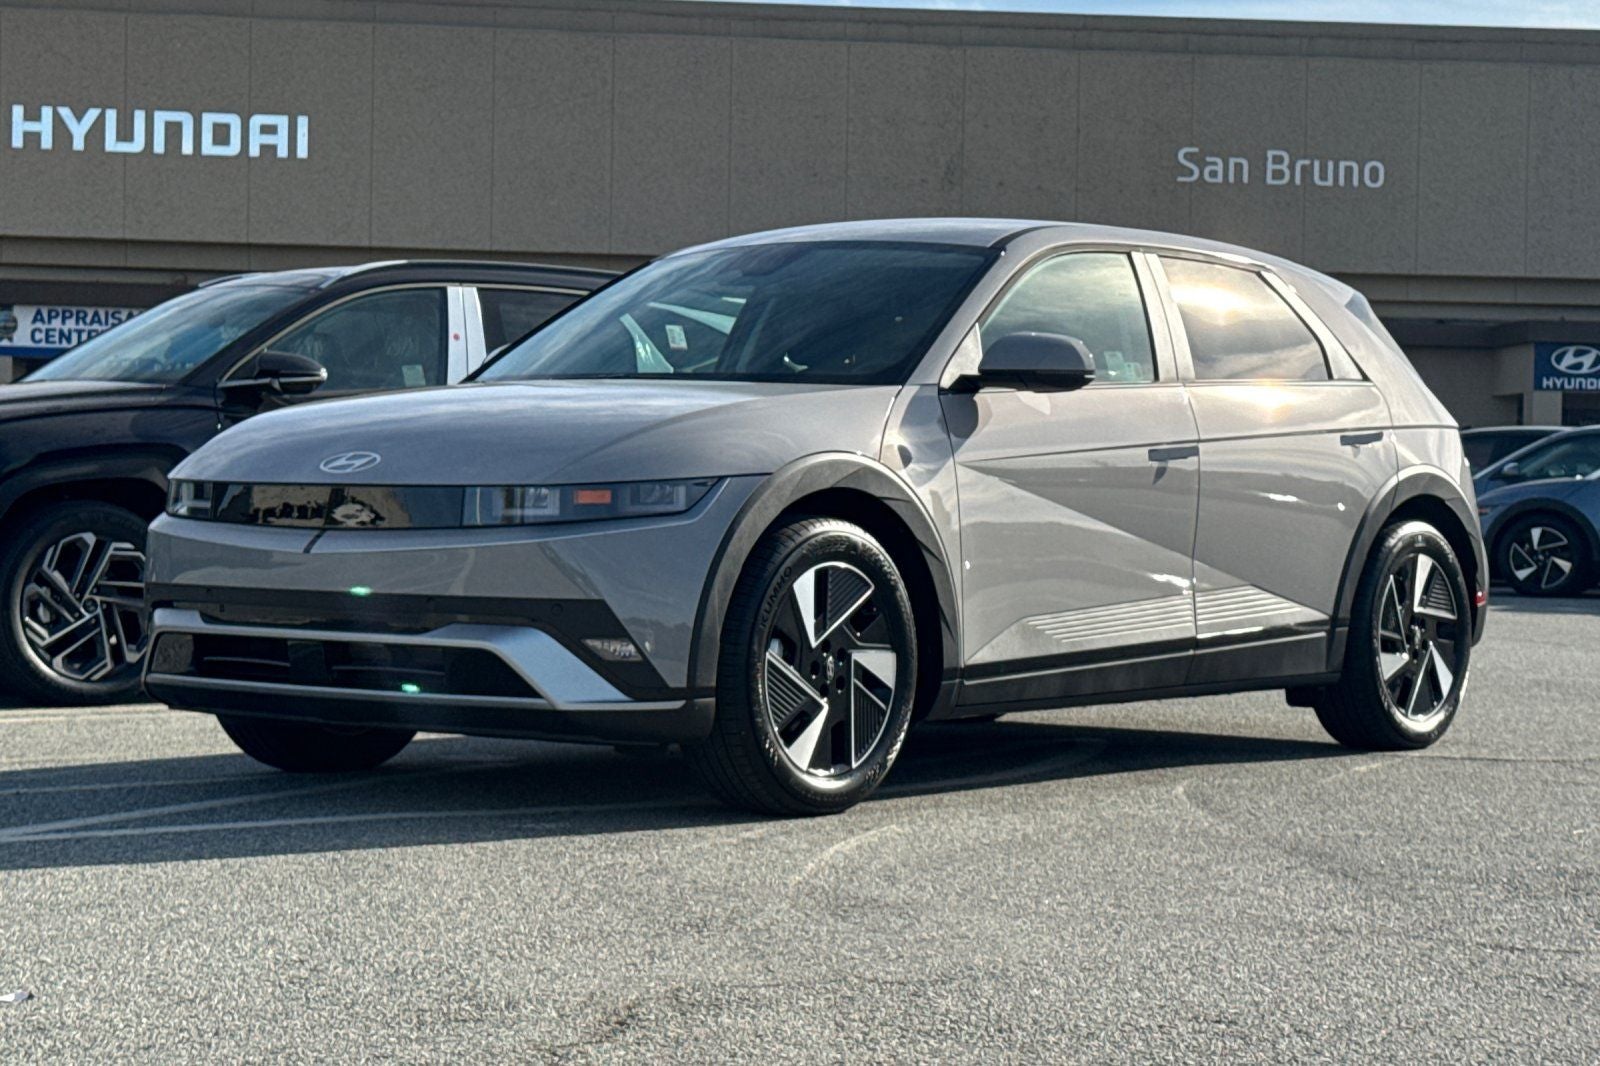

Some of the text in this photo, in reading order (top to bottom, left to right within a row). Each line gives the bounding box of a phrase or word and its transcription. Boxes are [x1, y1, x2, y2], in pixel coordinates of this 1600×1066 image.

[11, 104, 309, 159] HYUNDAI
[1176, 147, 1385, 188] San Bruno
[31, 308, 142, 327] APPRAIS
[1542, 376, 1600, 390] HYUND
